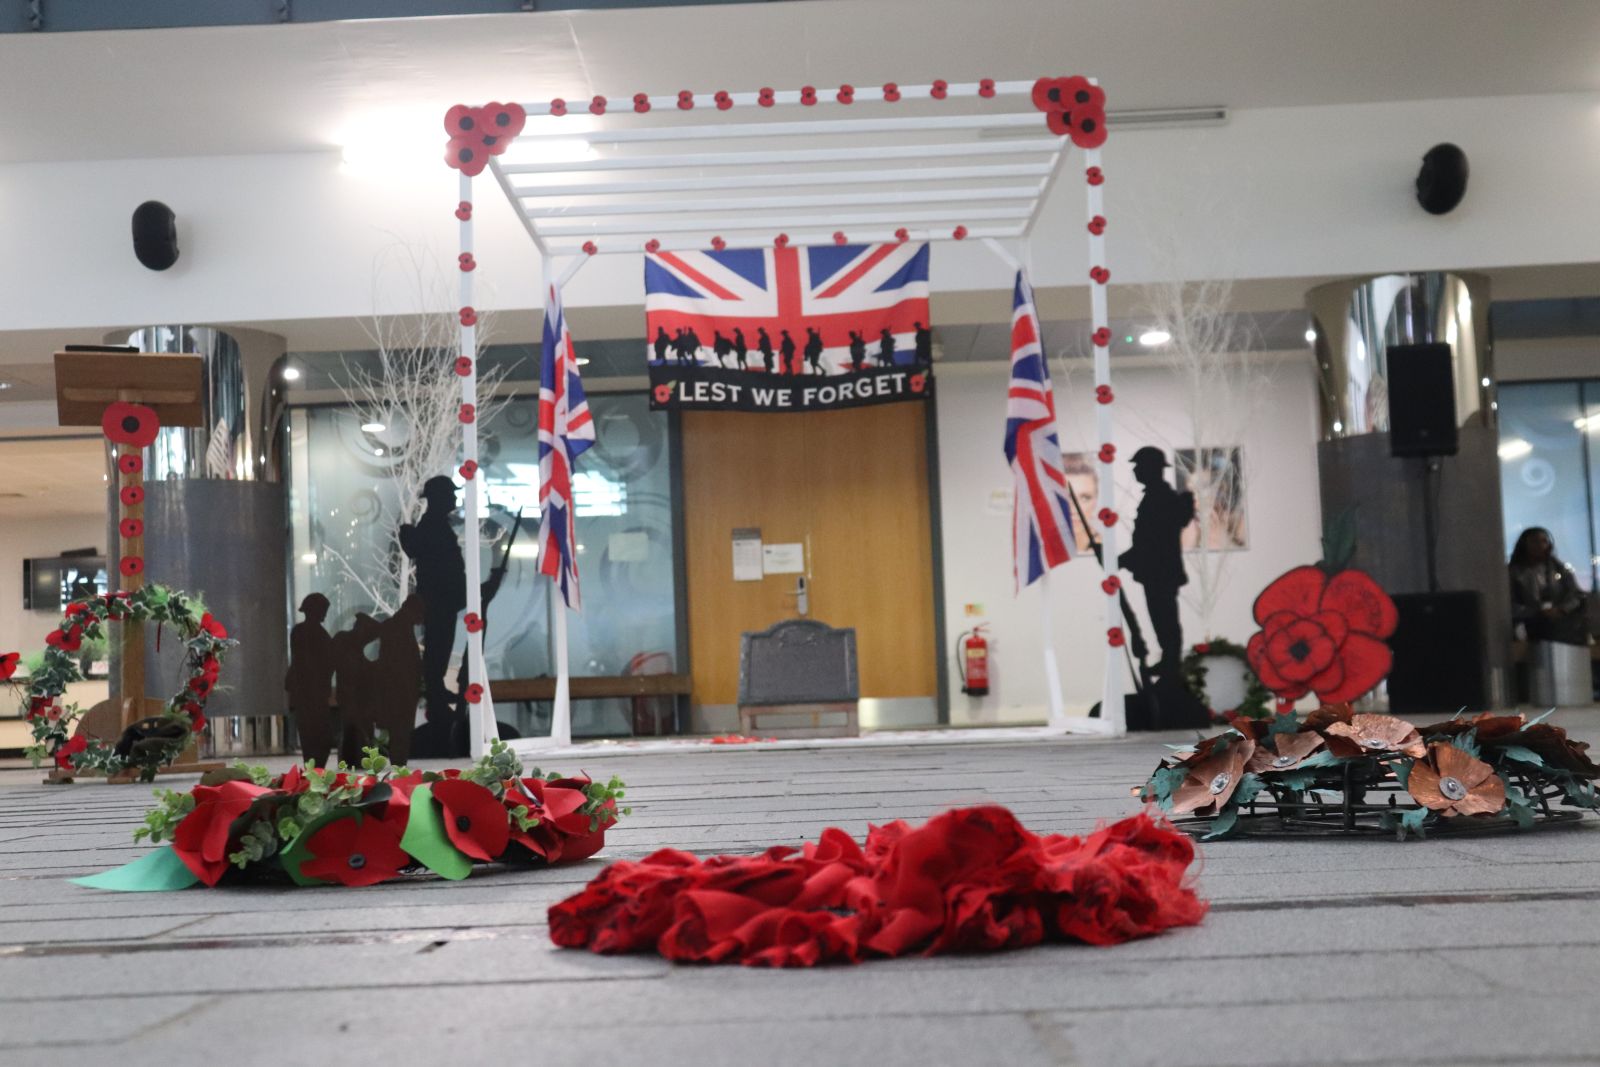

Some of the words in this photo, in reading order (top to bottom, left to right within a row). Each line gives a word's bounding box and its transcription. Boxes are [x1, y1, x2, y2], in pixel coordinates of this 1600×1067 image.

[679, 382, 742, 402] LEST
[752, 388, 792, 407] WE
[803, 373, 906, 406] FORGET
